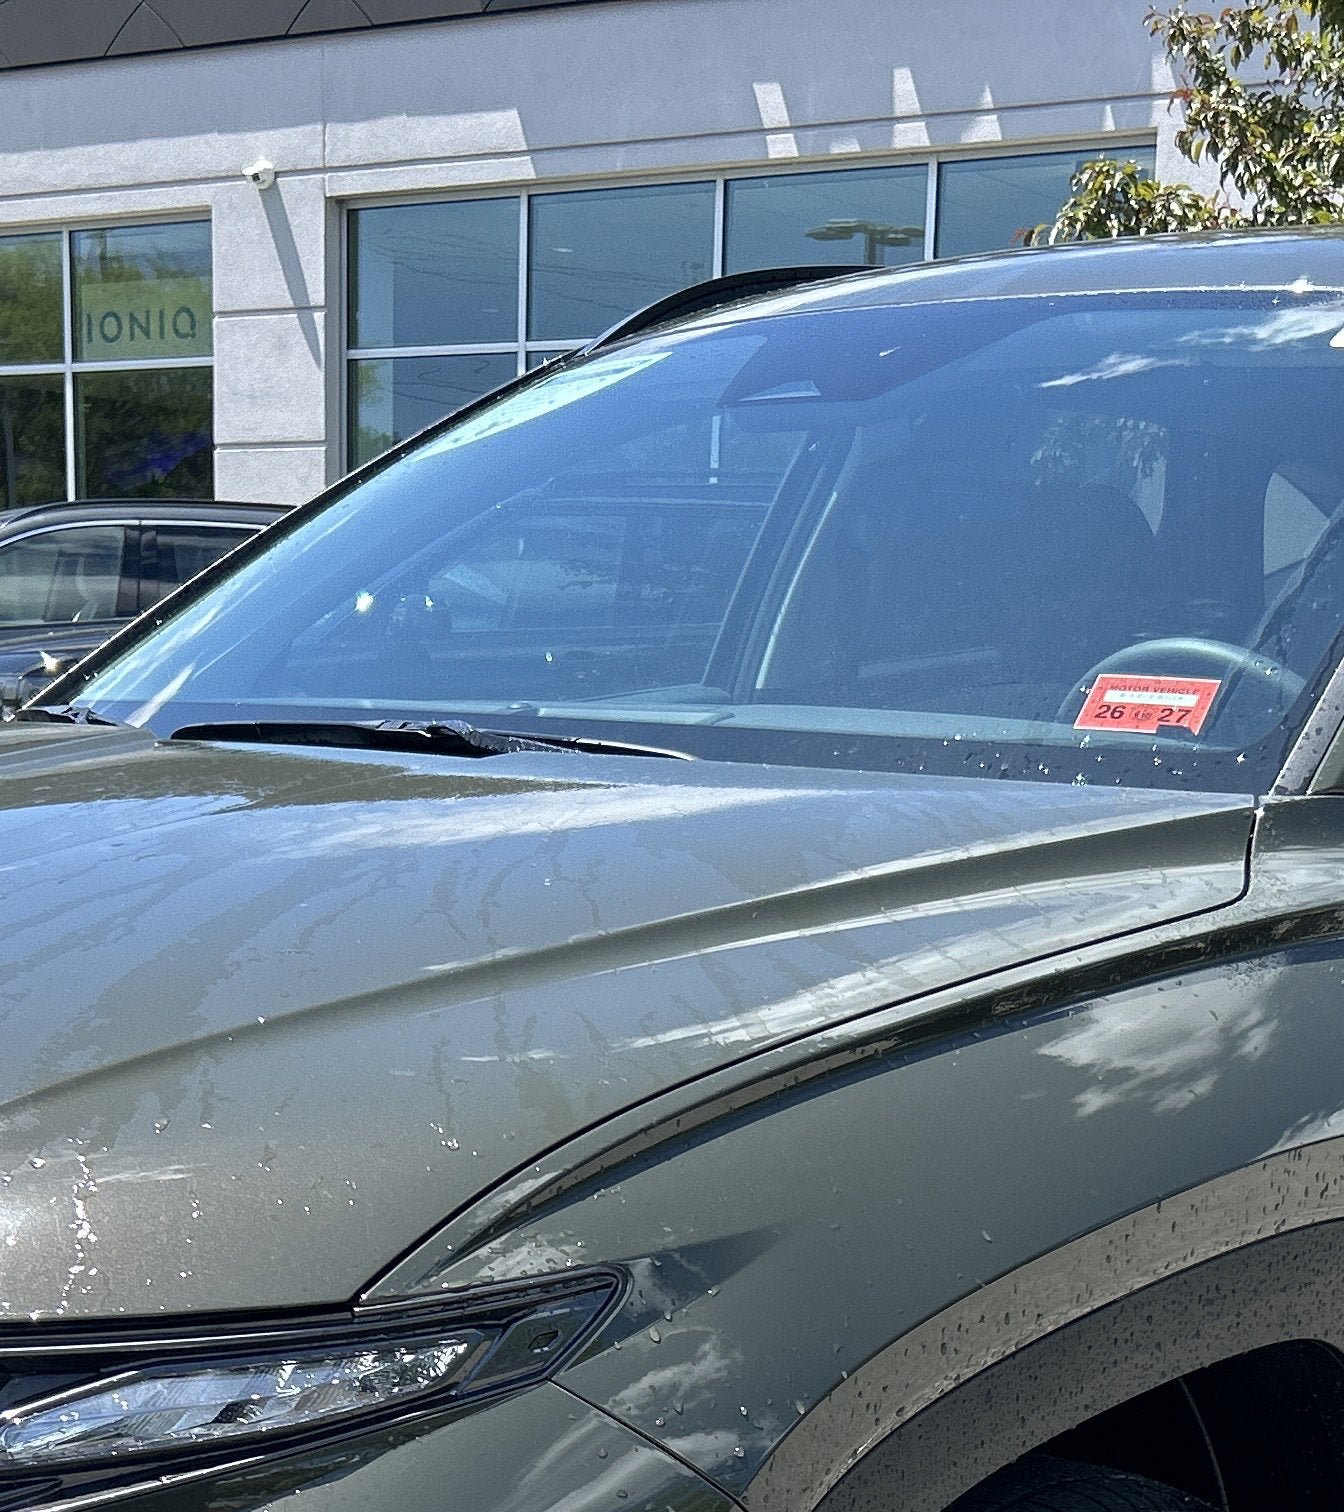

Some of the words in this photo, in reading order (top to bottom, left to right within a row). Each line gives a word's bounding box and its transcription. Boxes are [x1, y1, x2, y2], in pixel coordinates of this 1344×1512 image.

[86, 306, 197, 344] IONIQ
[1110, 684, 1149, 692] MOTOR
[1153, 687, 1200, 695] VEHICLE
[1094, 704, 1127, 720] 26
[1157, 708, 1192, 723] 27
